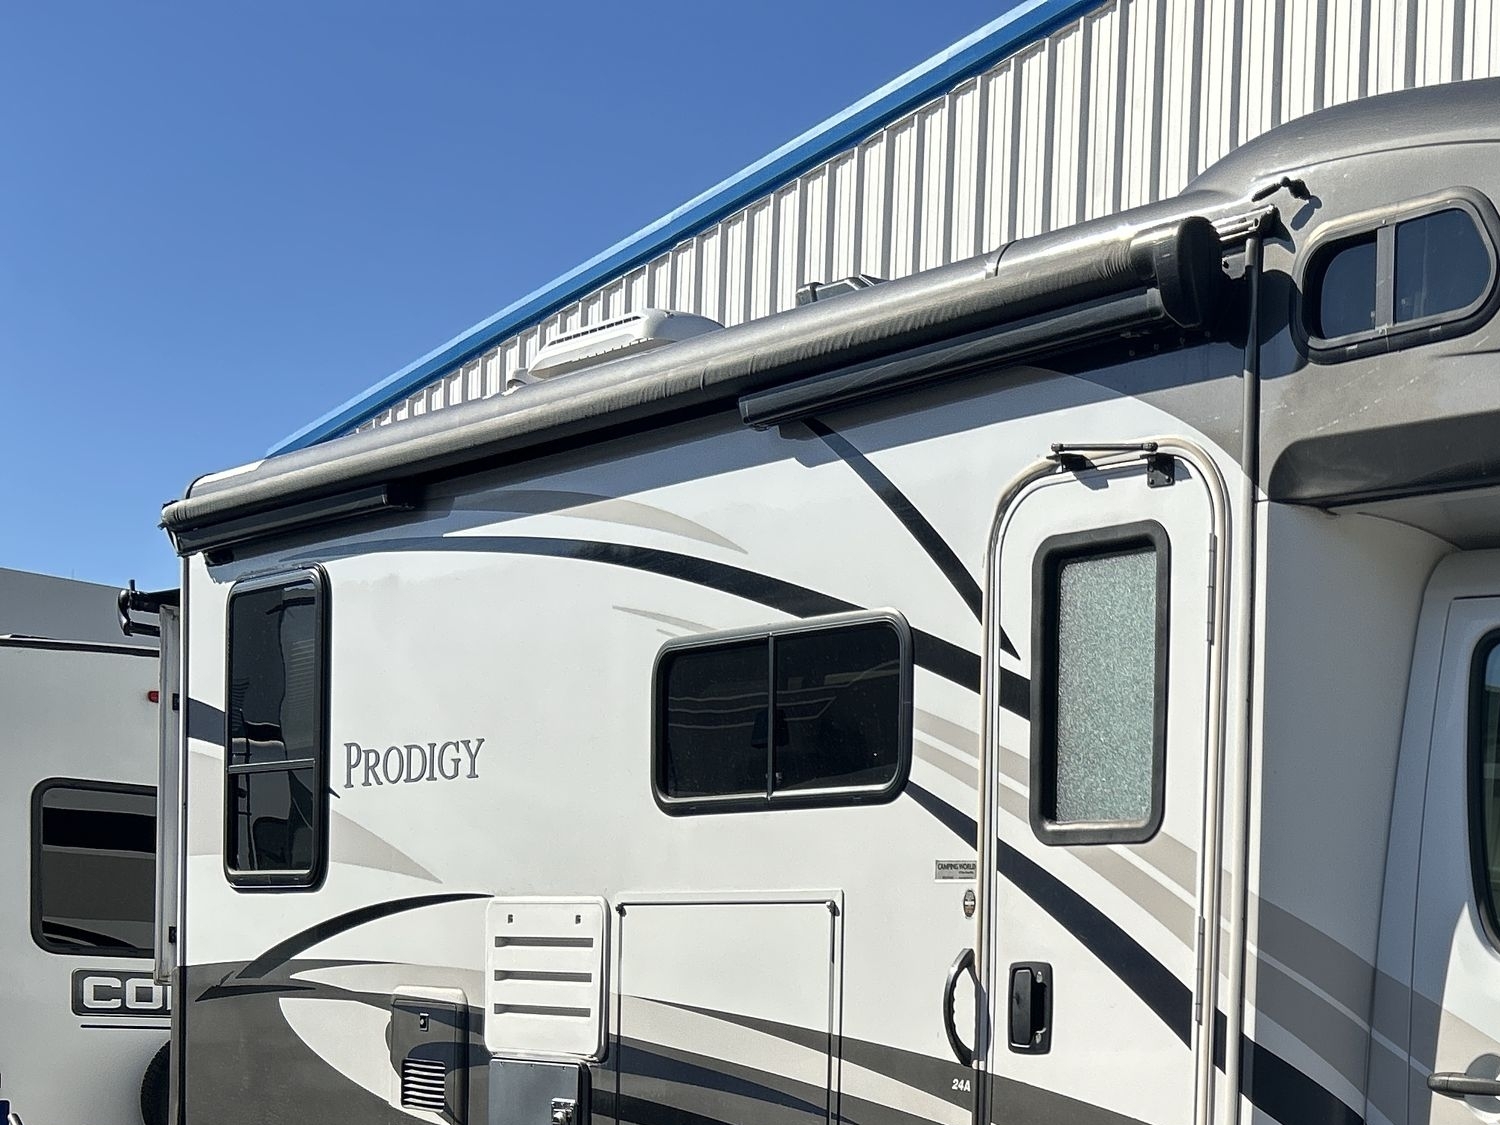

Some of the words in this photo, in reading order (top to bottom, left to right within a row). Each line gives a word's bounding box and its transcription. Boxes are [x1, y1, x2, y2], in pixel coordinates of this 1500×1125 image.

[343, 738, 485, 789] PRODIGY
[83, 976, 172, 1011] CO
[951, 1078, 971, 1092] 24A
